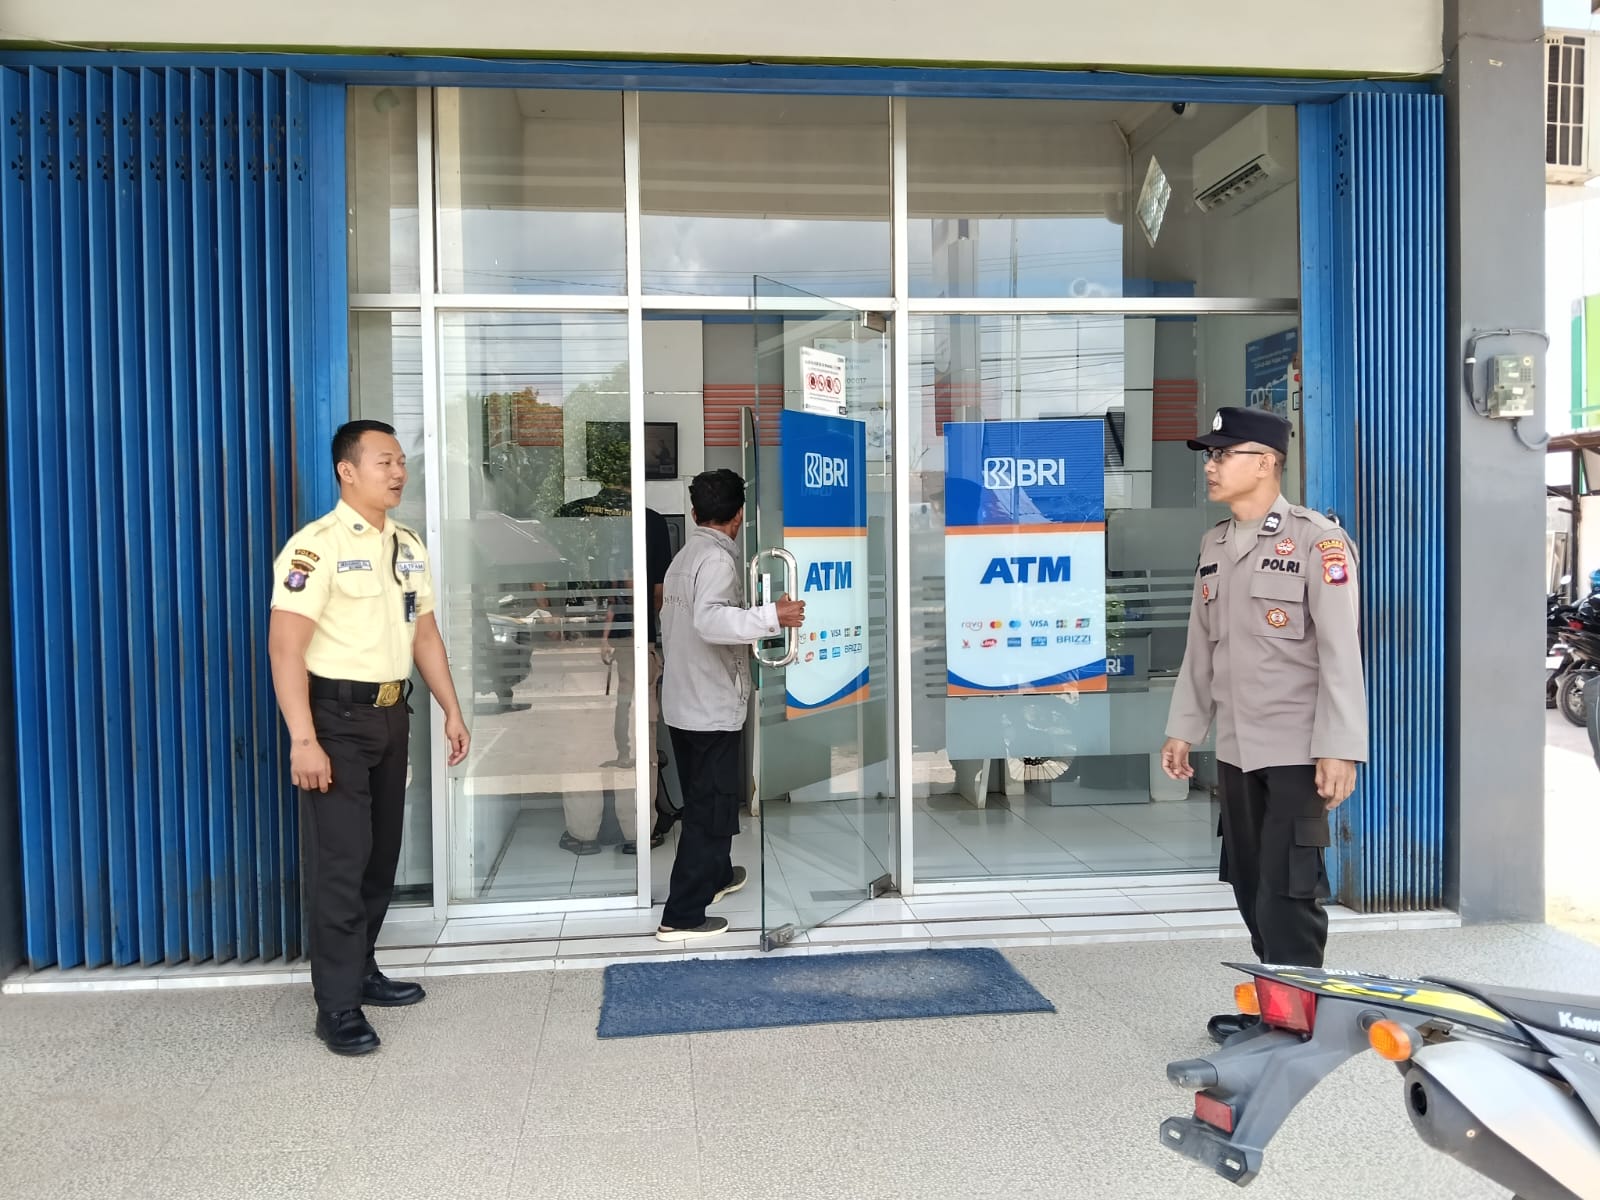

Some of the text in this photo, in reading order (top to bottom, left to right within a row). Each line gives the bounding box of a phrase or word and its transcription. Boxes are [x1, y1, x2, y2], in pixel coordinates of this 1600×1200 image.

[822, 456, 849, 487] BRI
[1016, 457, 1066, 486] BRI
[980, 556, 1072, 585] ATM
[1261, 558, 1300, 574] POLRI
[804, 560, 852, 592] ATM
[1029, 619, 1049, 628] VISA
[830, 629, 842, 638] VISA
[1056, 634, 1092, 644] BRIZZI
[1105, 658, 1121, 673] RI
[1558, 1011, 1600, 1033] Kaw
